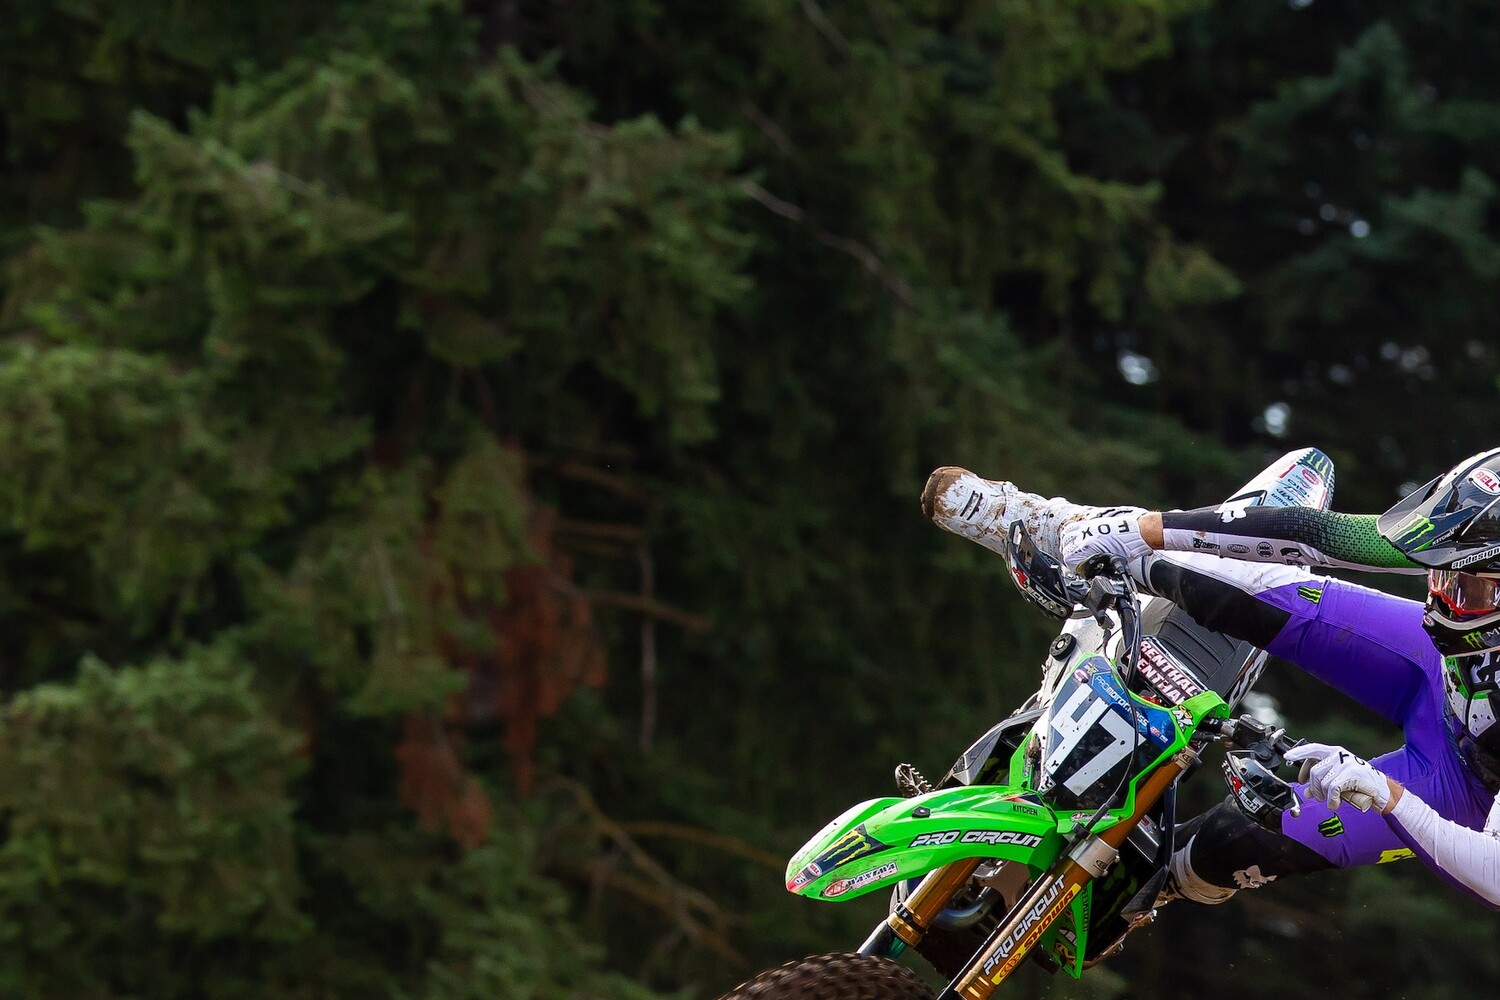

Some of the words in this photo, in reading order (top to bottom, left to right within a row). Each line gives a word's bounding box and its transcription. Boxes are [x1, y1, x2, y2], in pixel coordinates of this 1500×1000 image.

[1474, 470, 1498, 492] BELL
[1082, 519, 1129, 541] FOX
[1140, 639, 1206, 696] RENTHAL
[1045, 683, 1147, 797] 47
[1012, 804, 1038, 816] KITCHEN
[911, 831, 959, 848] PRO
[960, 830, 1045, 848] CIRCUIT
[983, 939, 1016, 976] PRO
[1012, 873, 1066, 943] CIRCUIT
[1023, 889, 1075, 951] SHOWA
